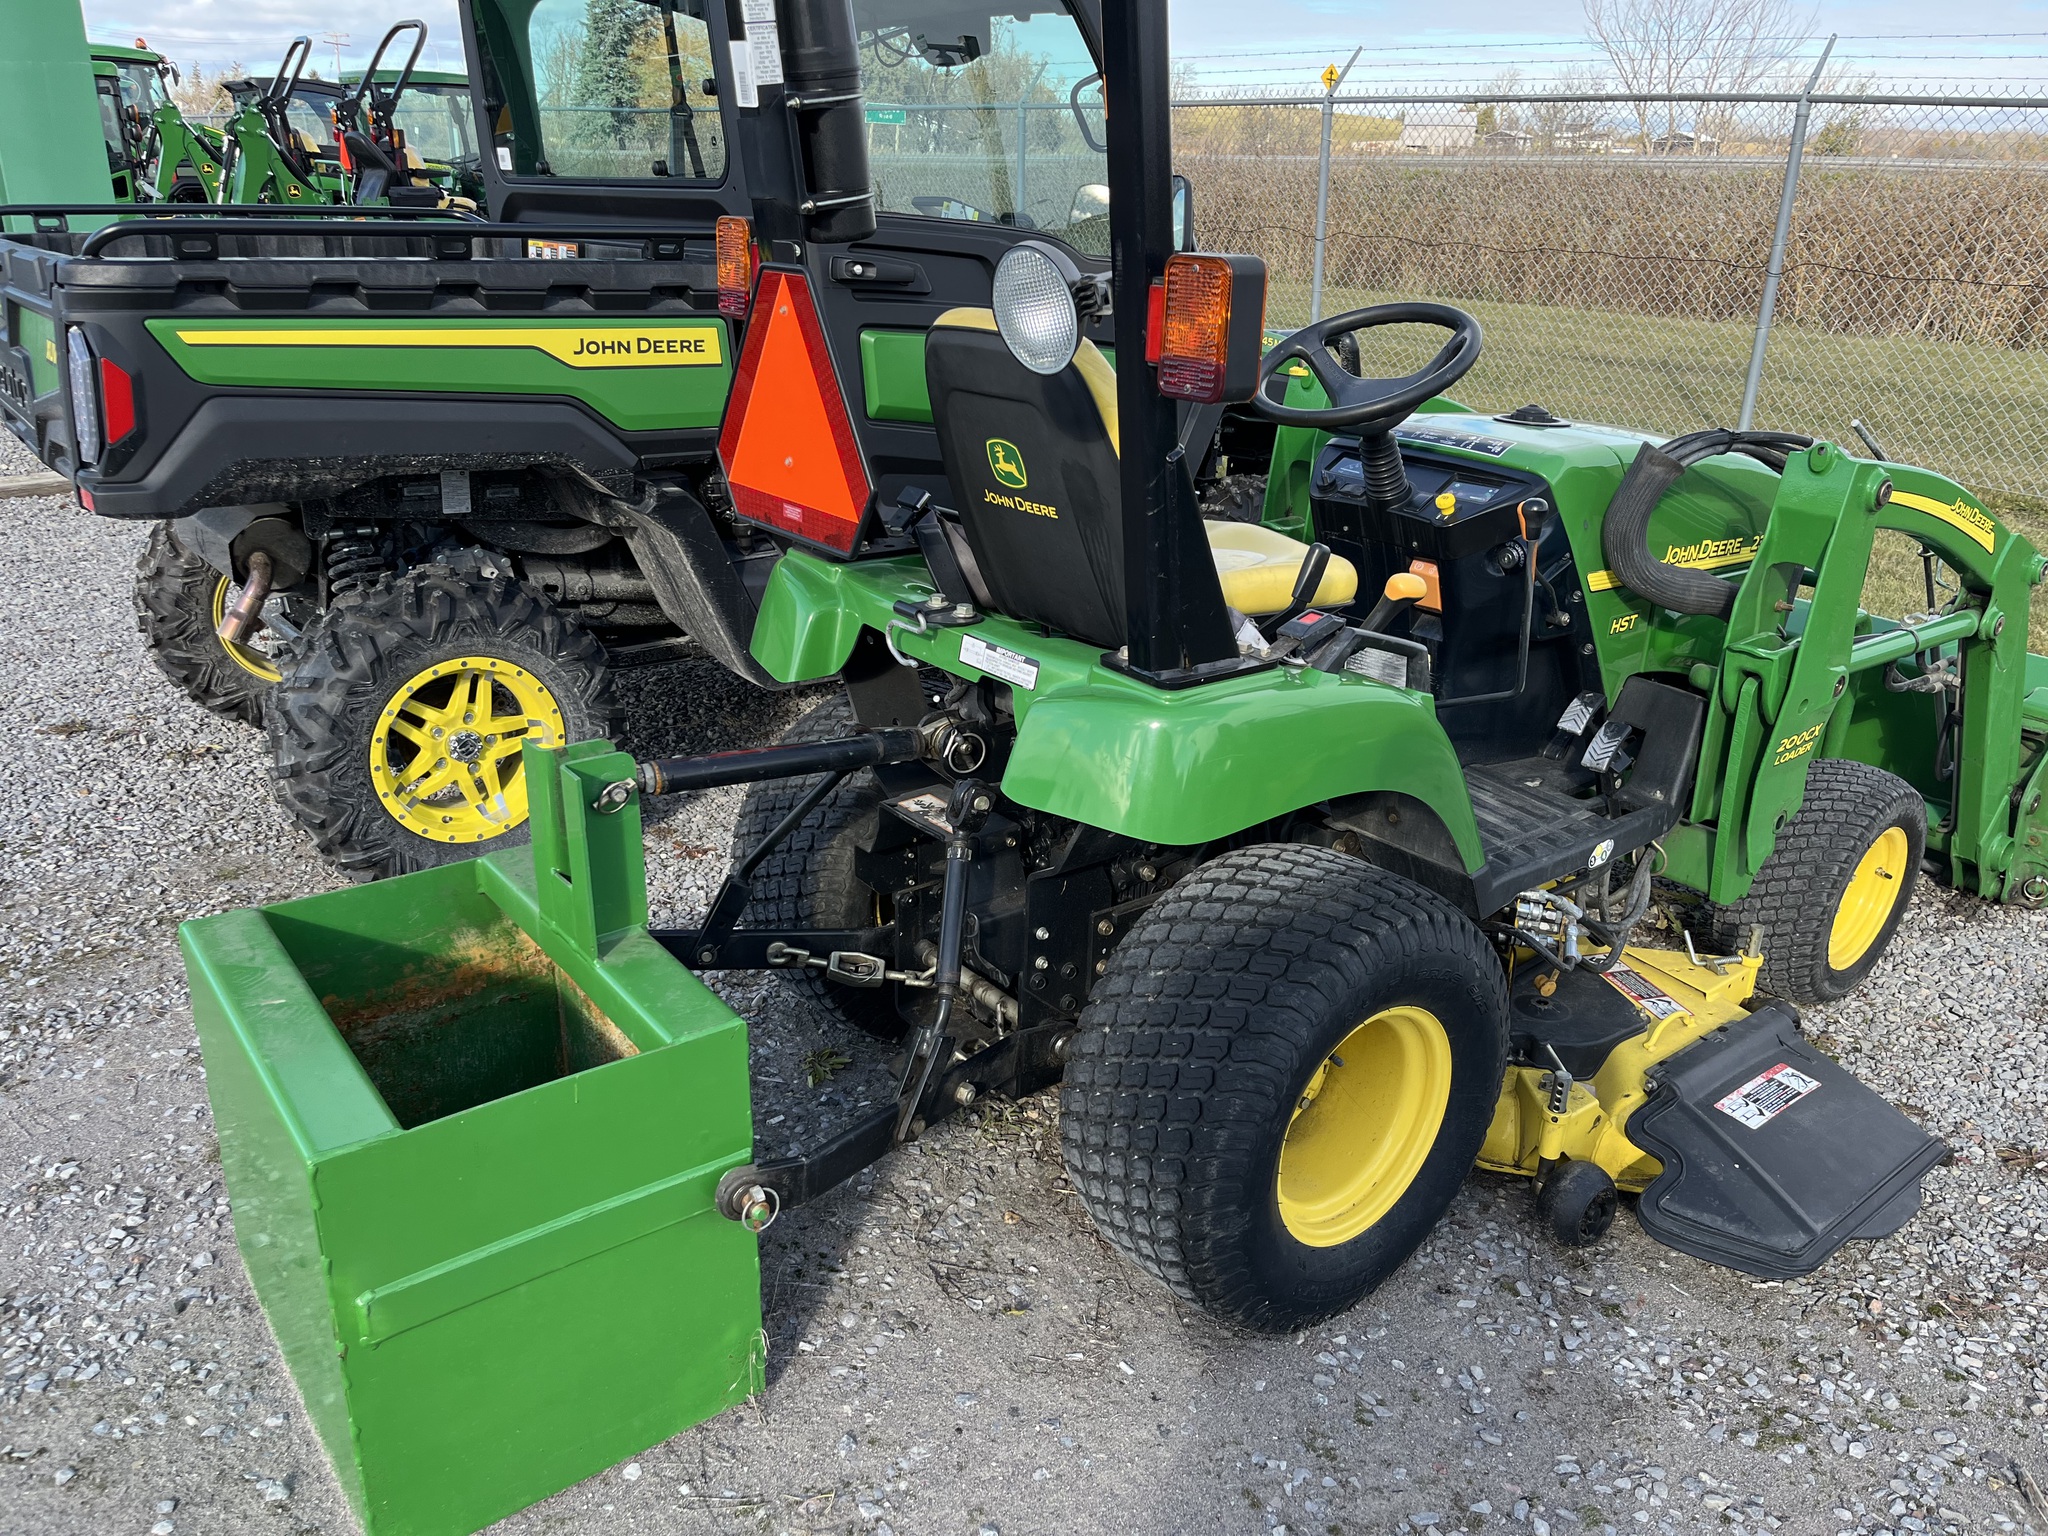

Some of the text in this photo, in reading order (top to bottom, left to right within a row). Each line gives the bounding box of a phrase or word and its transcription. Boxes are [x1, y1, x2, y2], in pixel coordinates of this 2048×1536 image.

[573, 337, 706, 355] JOHN DEERE
[984, 488, 1059, 519] JOHN DEERE
[1950, 496, 1996, 533] JOHN DEERE
[1660, 534, 1765, 564] JOHN DEERE 2
[1610, 613, 1639, 635] HST
[996, 646, 1026, 663] IMPORTANT
[1775, 722, 1824, 753] 200CX
[1773, 741, 1814, 766] LOADER
